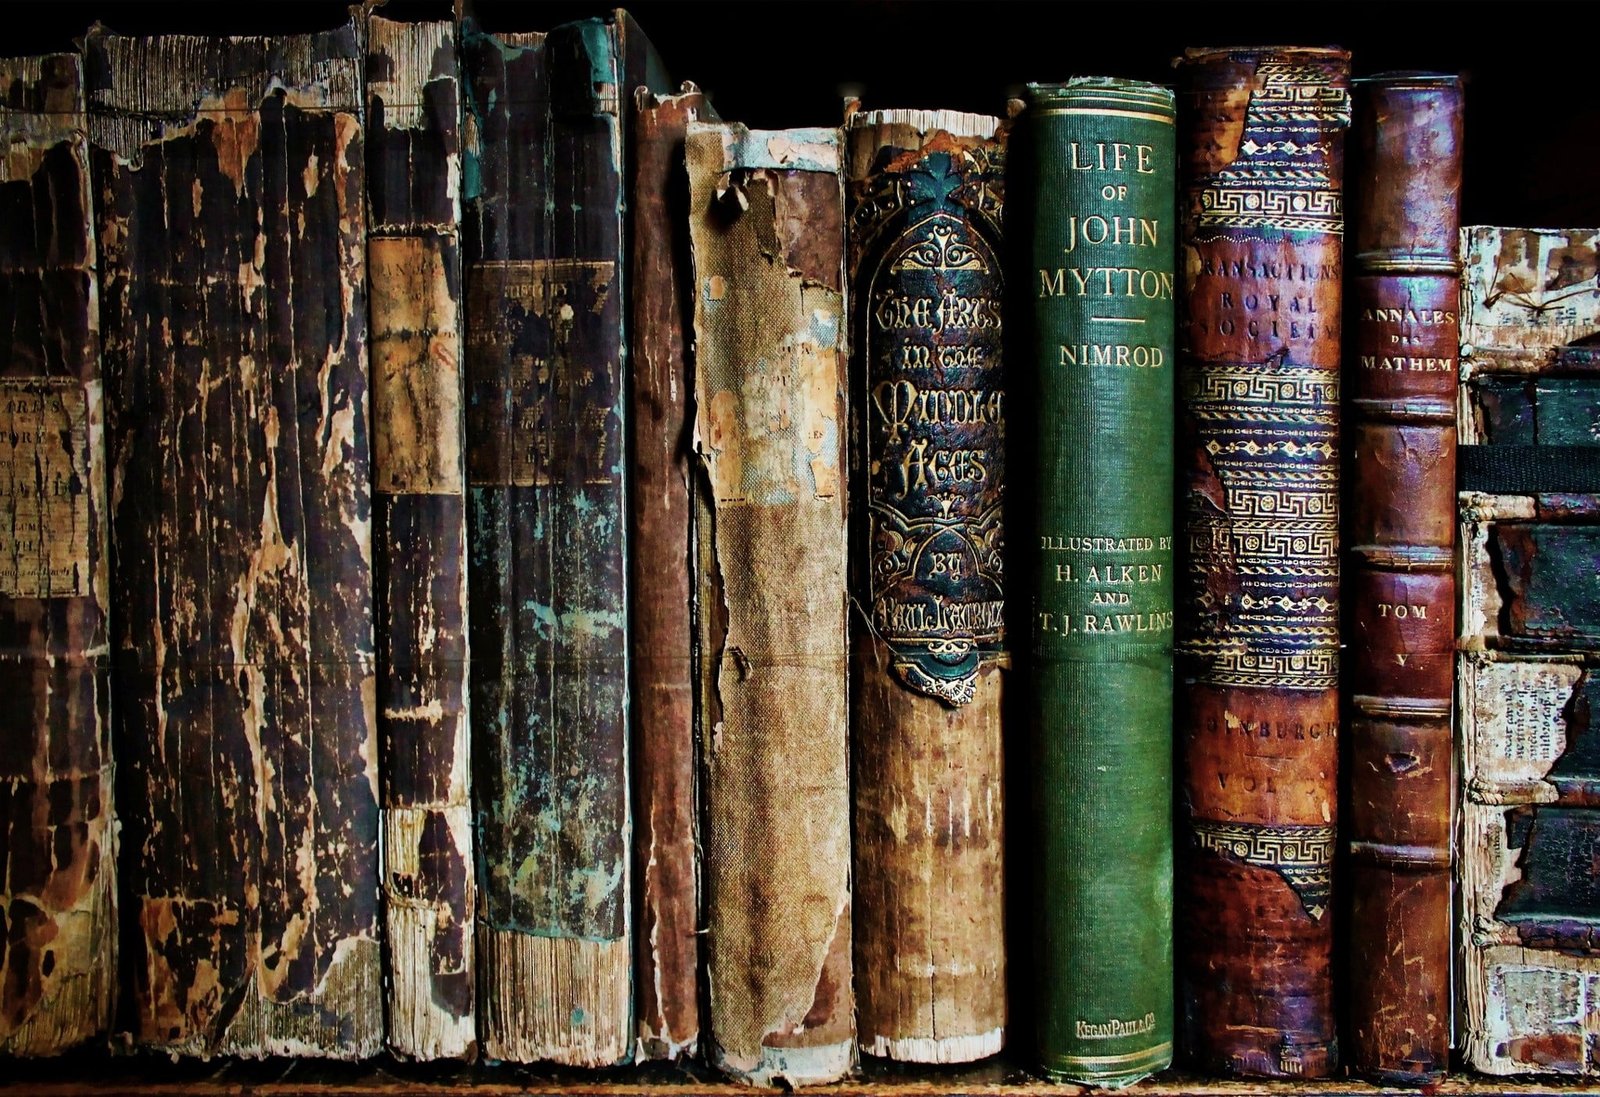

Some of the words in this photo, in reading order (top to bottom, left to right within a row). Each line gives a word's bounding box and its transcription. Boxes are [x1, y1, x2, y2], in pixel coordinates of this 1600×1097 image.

[1070, 141, 1154, 175] LIFE
[1101, 184, 1128, 202] OF
[1063, 214, 1158, 254] JOHN
[1039, 266, 1174, 301] MYTTON
[1220, 291, 1317, 314] ROYAL
[1362, 307, 1455, 325] ANNALES
[1059, 344, 1164, 369] NIMROD
[1040, 536, 1154, 551] ILLUSTRATED
[1159, 536, 1173, 550] BY
[1055, 564, 1080, 583] H.
[1086, 564, 1163, 583] ALKEN
[1089, 593, 1131, 605] AND
[1083, 612, 1174, 633] RAWLINS
